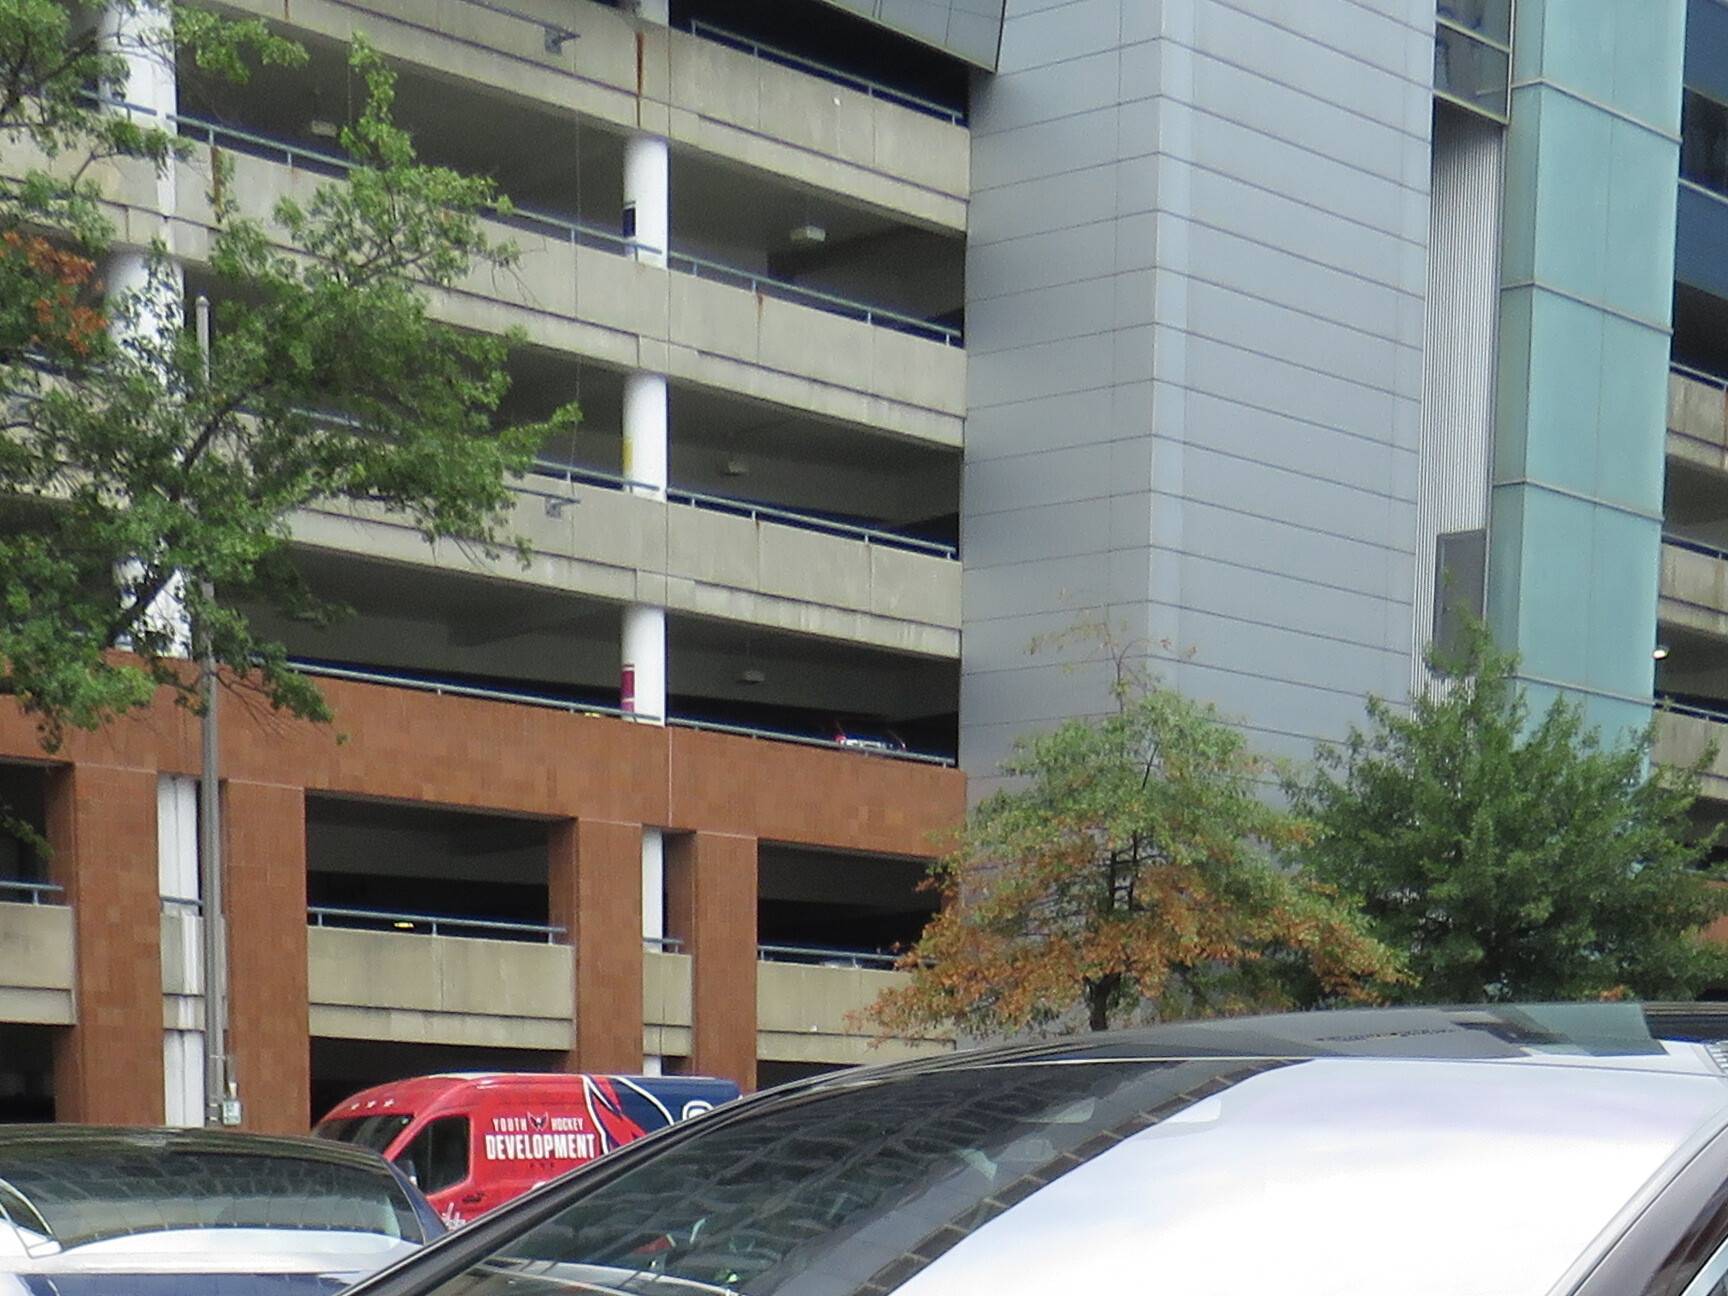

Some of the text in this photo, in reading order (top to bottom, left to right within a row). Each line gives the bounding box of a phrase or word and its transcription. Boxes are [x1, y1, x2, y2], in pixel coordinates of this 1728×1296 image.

[492, 1116, 584, 1132] YOUTH HOCKEY
[484, 1133, 596, 1161] DEVELOPMENT
